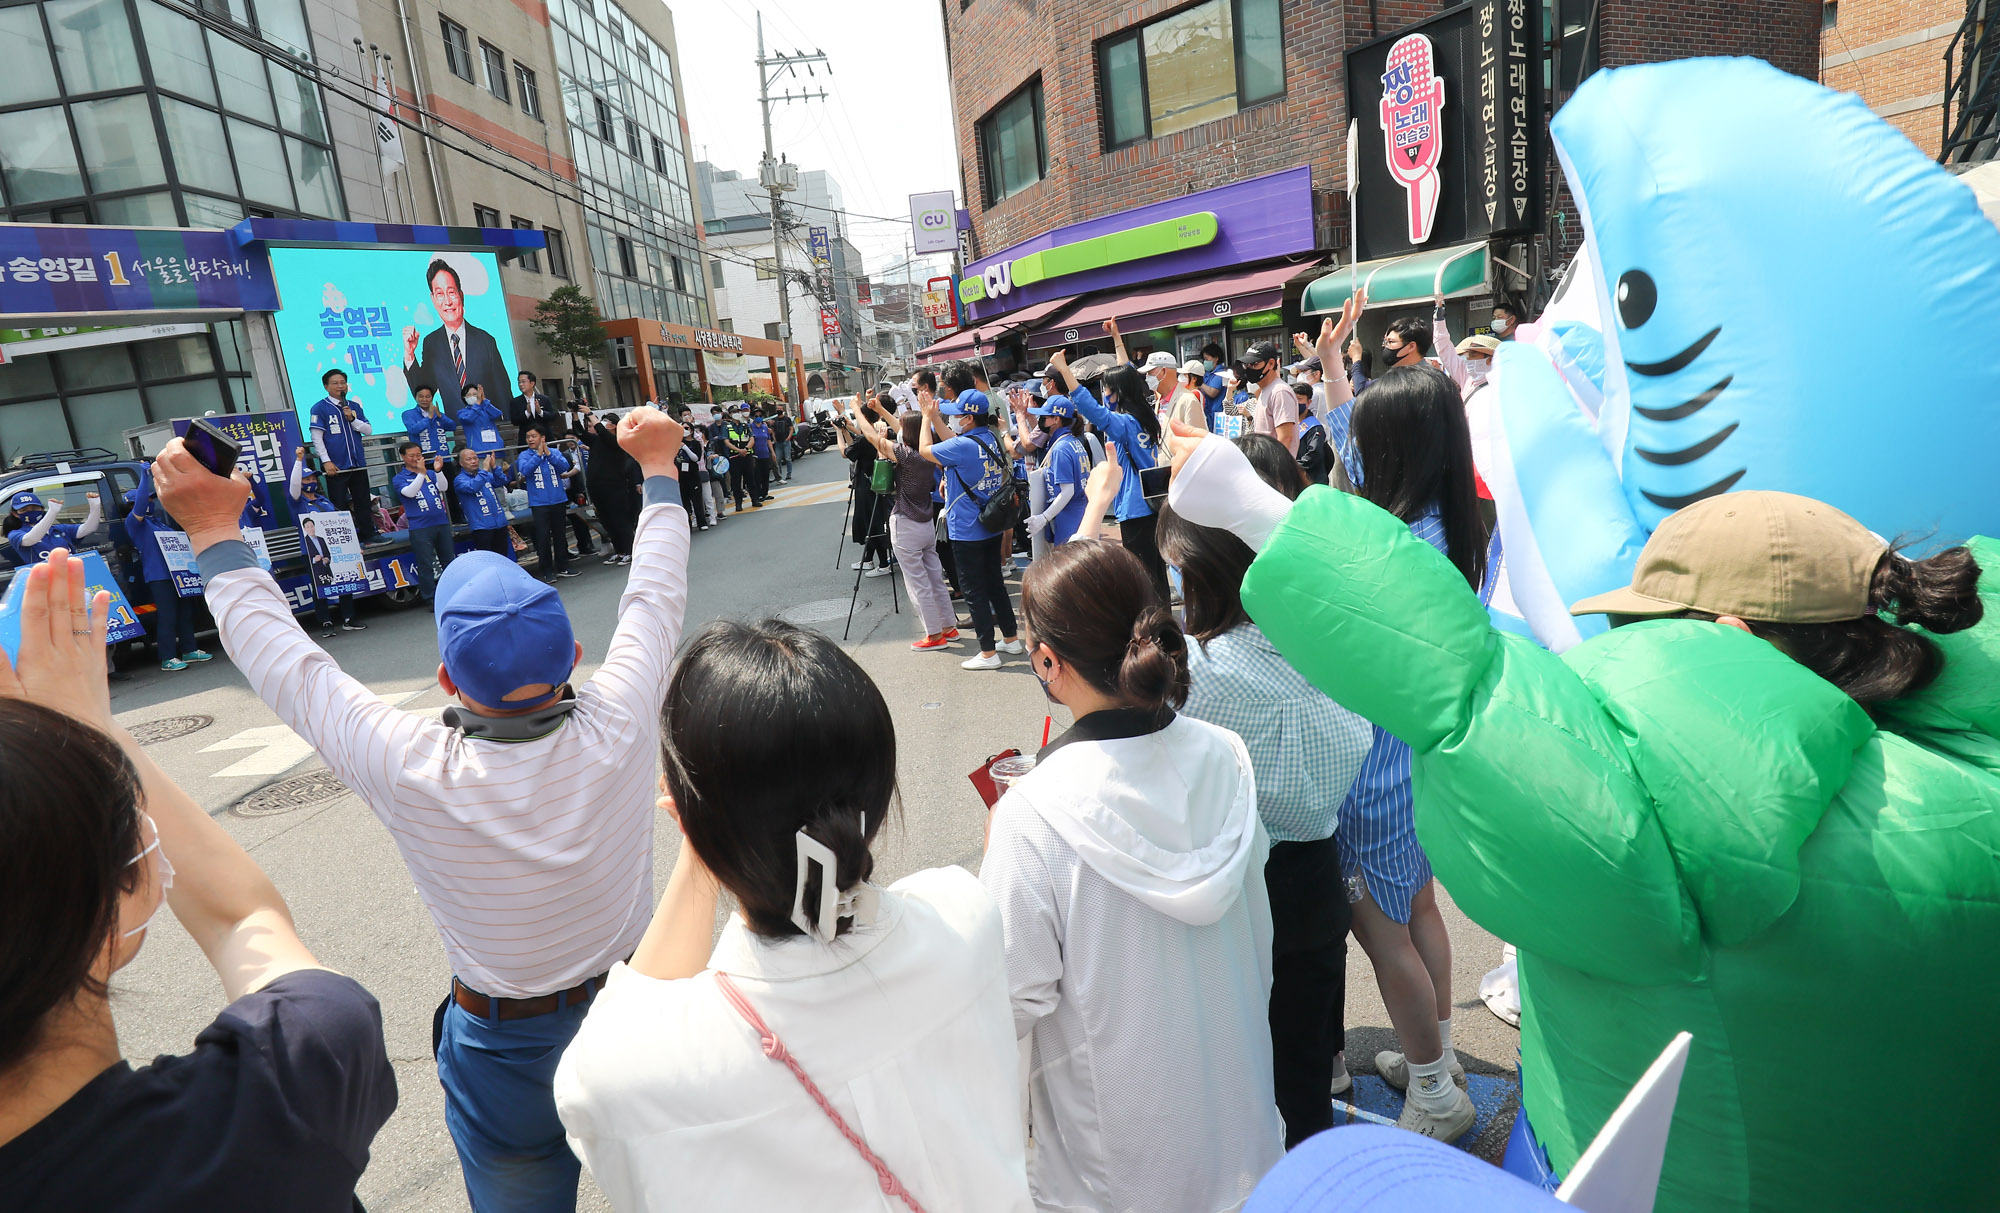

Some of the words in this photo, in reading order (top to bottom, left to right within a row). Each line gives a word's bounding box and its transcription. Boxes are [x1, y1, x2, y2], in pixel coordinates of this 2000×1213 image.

[1382, 61, 1414, 105] 짱
[1395, 101, 1429, 130] 노래
[1396, 125, 1430, 147] 연습장
[1408, 147, 1419, 157] B1
[924, 214, 944, 226] CU
[8, 256, 98, 283] 송영길
[103, 251, 131, 286] 1
[962, 286, 973, 297] Nice
[974, 285, 980, 295] to
[984, 261, 1011, 299] CU
[923, 303, 948, 315] 부동산
[1216, 303, 1229, 314] CU
[319, 306, 393, 339] 송영길
[1066, 331, 1077, 340] CU
[347, 343, 383, 374] 1번
[176, 574, 185, 588] 1
[357, 562, 366, 579] 1
[117, 605, 135, 626] 1
